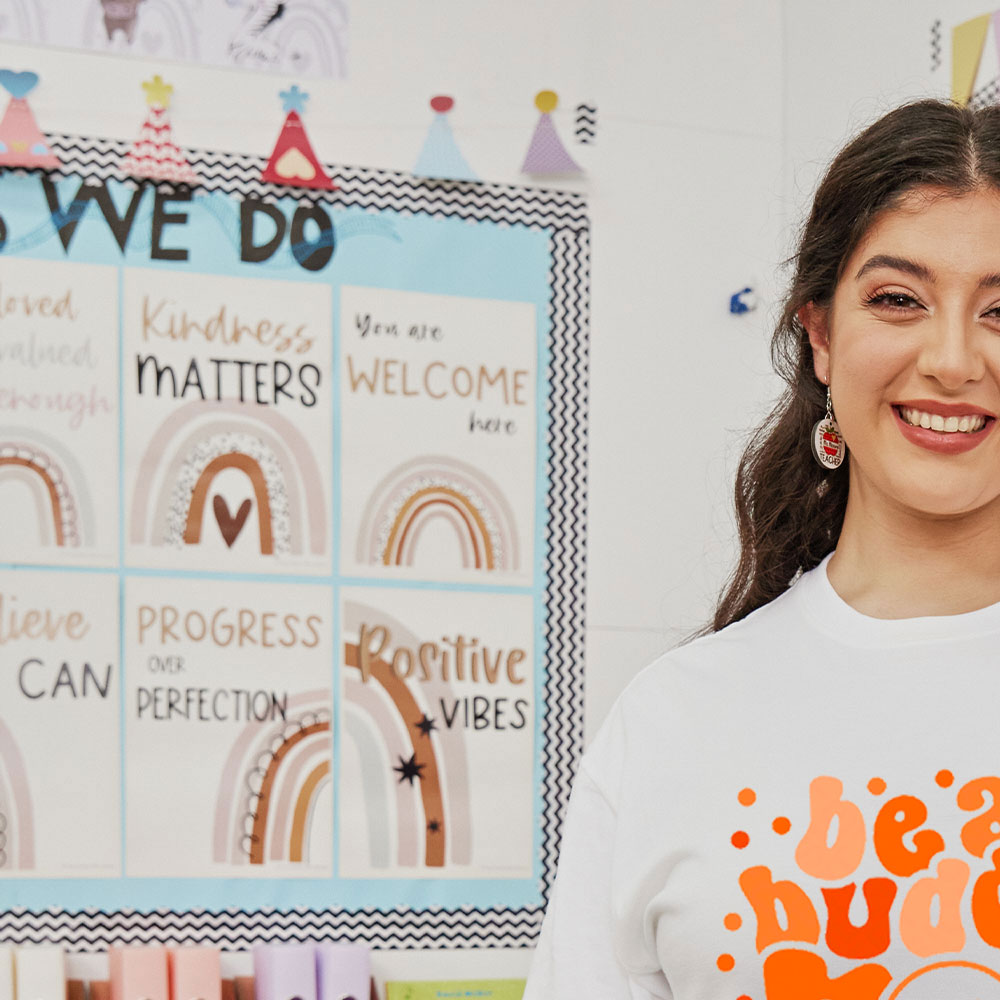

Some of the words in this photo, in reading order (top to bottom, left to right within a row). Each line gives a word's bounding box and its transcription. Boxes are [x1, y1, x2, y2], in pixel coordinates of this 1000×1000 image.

[42, 175, 193, 261] WE
[240, 197, 335, 272] DO
[0, 283, 79, 322] oved
[141, 295, 317, 354] Kindness
[355, 313, 398, 338] You
[409, 323, 443, 341] are
[0, 332, 98, 370] alued
[347, 354, 529, 406] WELCOME
[469, 410, 517, 434] here
[137, 605, 323, 648] PROGRESS
[149, 656, 185, 674] OVER
[360, 623, 526, 685] Positive
[18, 658, 113, 700] CAN
[136, 687, 288, 722] PERFECTION
[439, 695, 529, 730] VIBES
[795, 775, 946, 881] be
